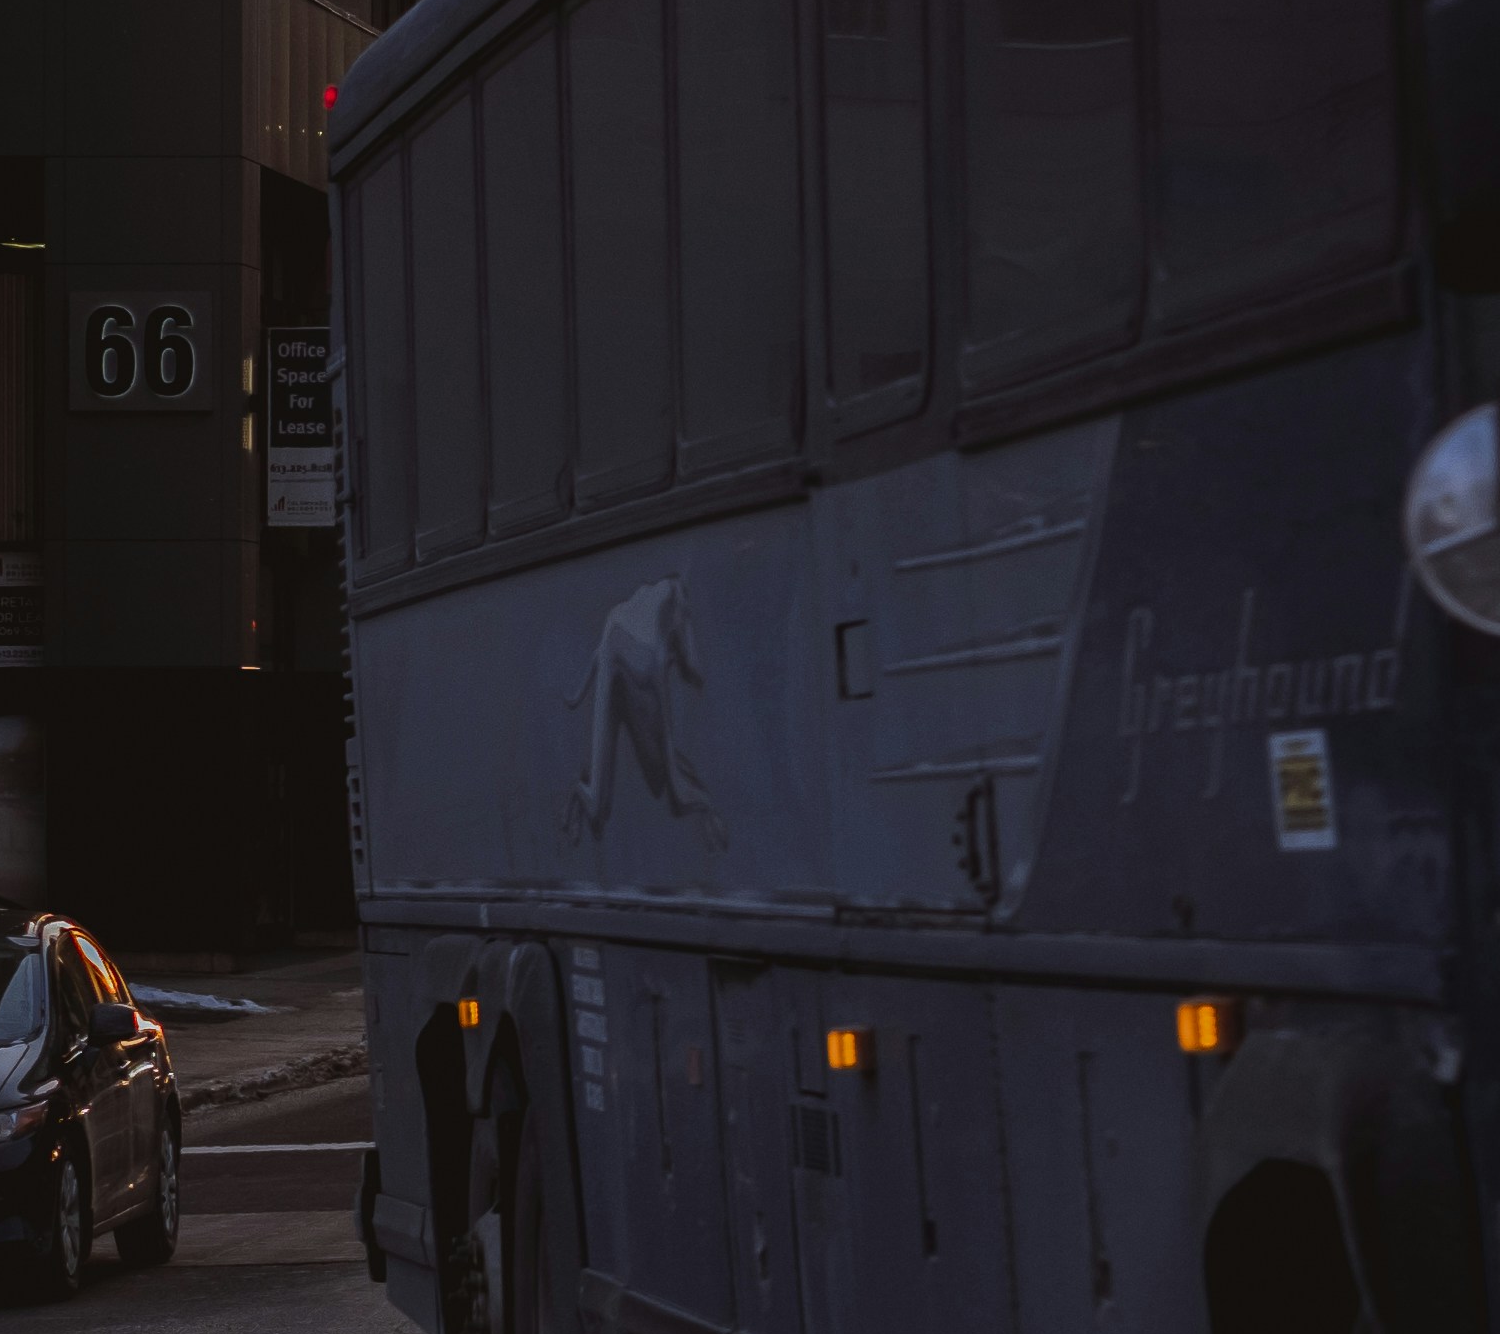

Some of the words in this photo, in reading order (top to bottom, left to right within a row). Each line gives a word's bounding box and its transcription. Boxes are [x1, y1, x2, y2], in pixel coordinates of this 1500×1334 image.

[84, 303, 196, 398] 66
[277, 342, 326, 358] Office
[277, 368, 326, 386] Space
[289, 394, 315, 409] For
[278, 420, 326, 434] Lease
[0, 596, 34, 608] RETA
[18, 612, 44, 623] LEA
